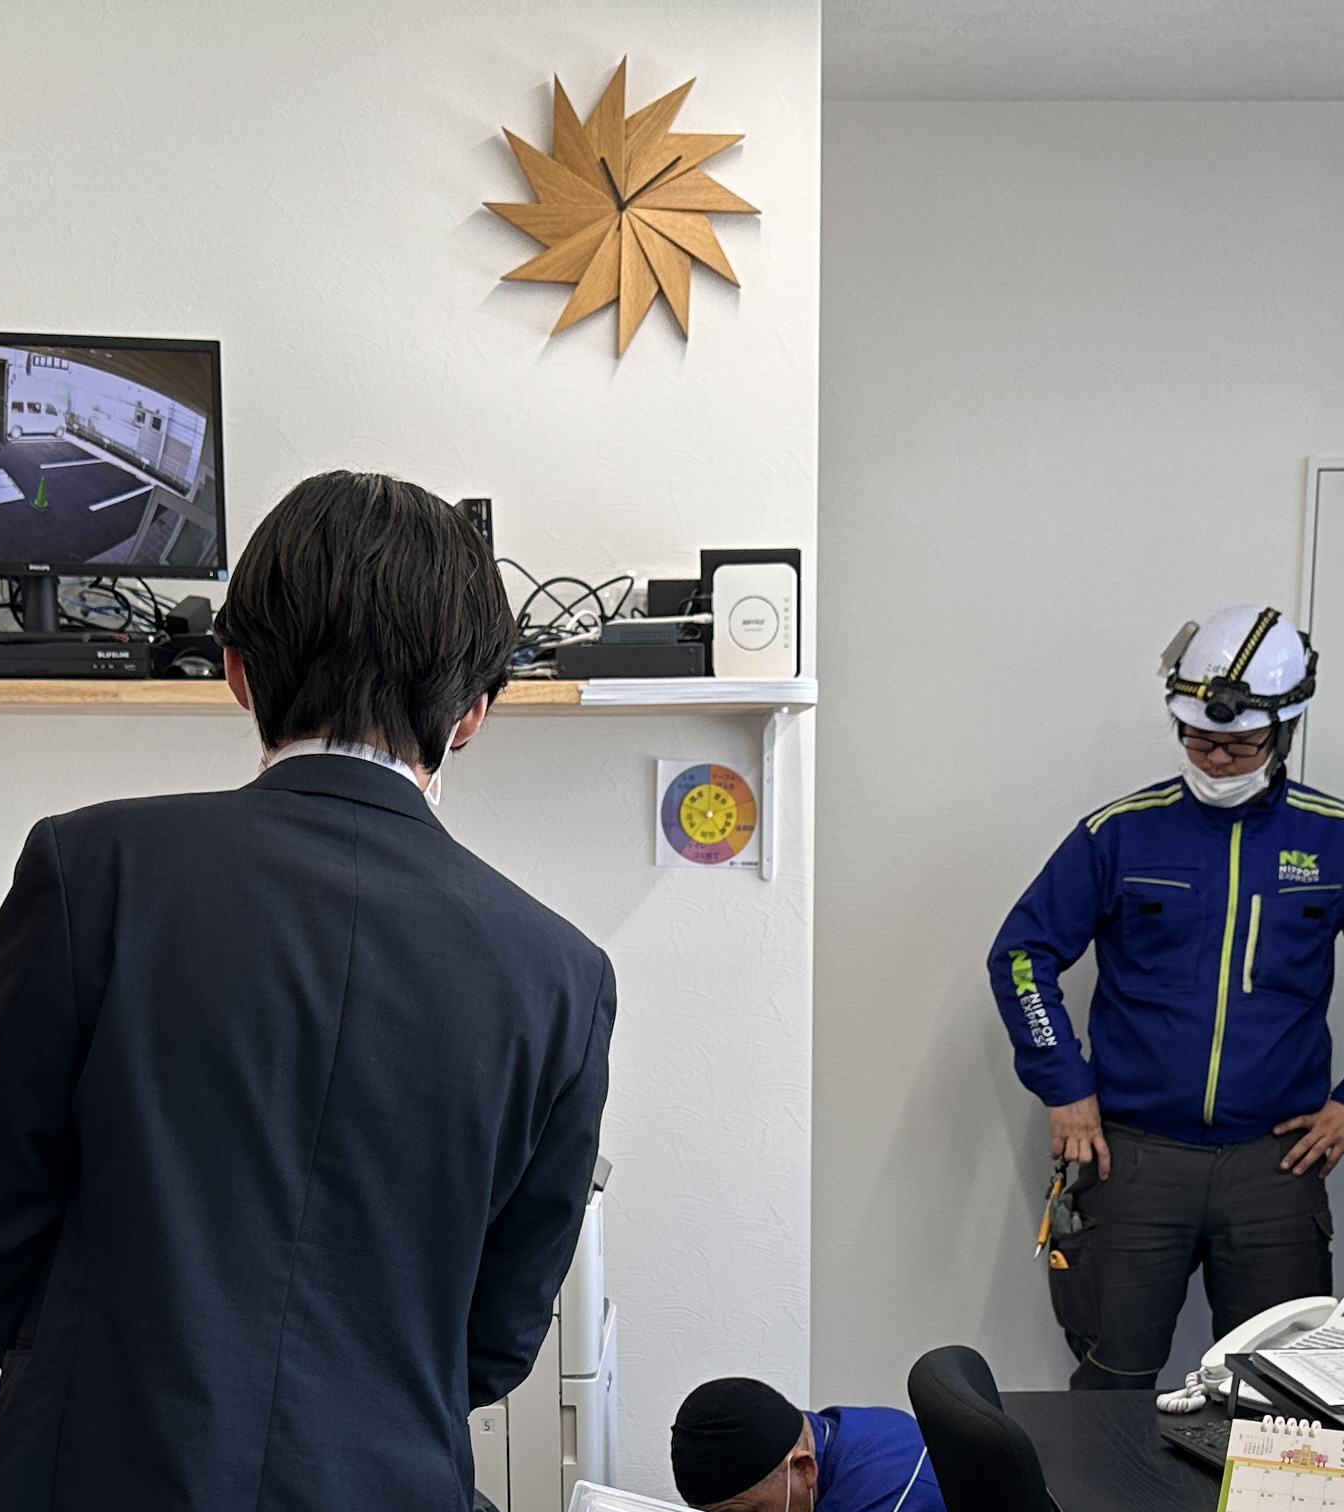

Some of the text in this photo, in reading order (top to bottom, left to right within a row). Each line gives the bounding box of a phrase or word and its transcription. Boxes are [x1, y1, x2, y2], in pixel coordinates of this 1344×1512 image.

[1279, 849, 1319, 869] NX
[1279, 865, 1320, 877] NIPPON
[1008, 949, 1038, 997] NX
[1030, 992, 1058, 1047] NIPPON
[484, 1420, 491, 1431] 5
